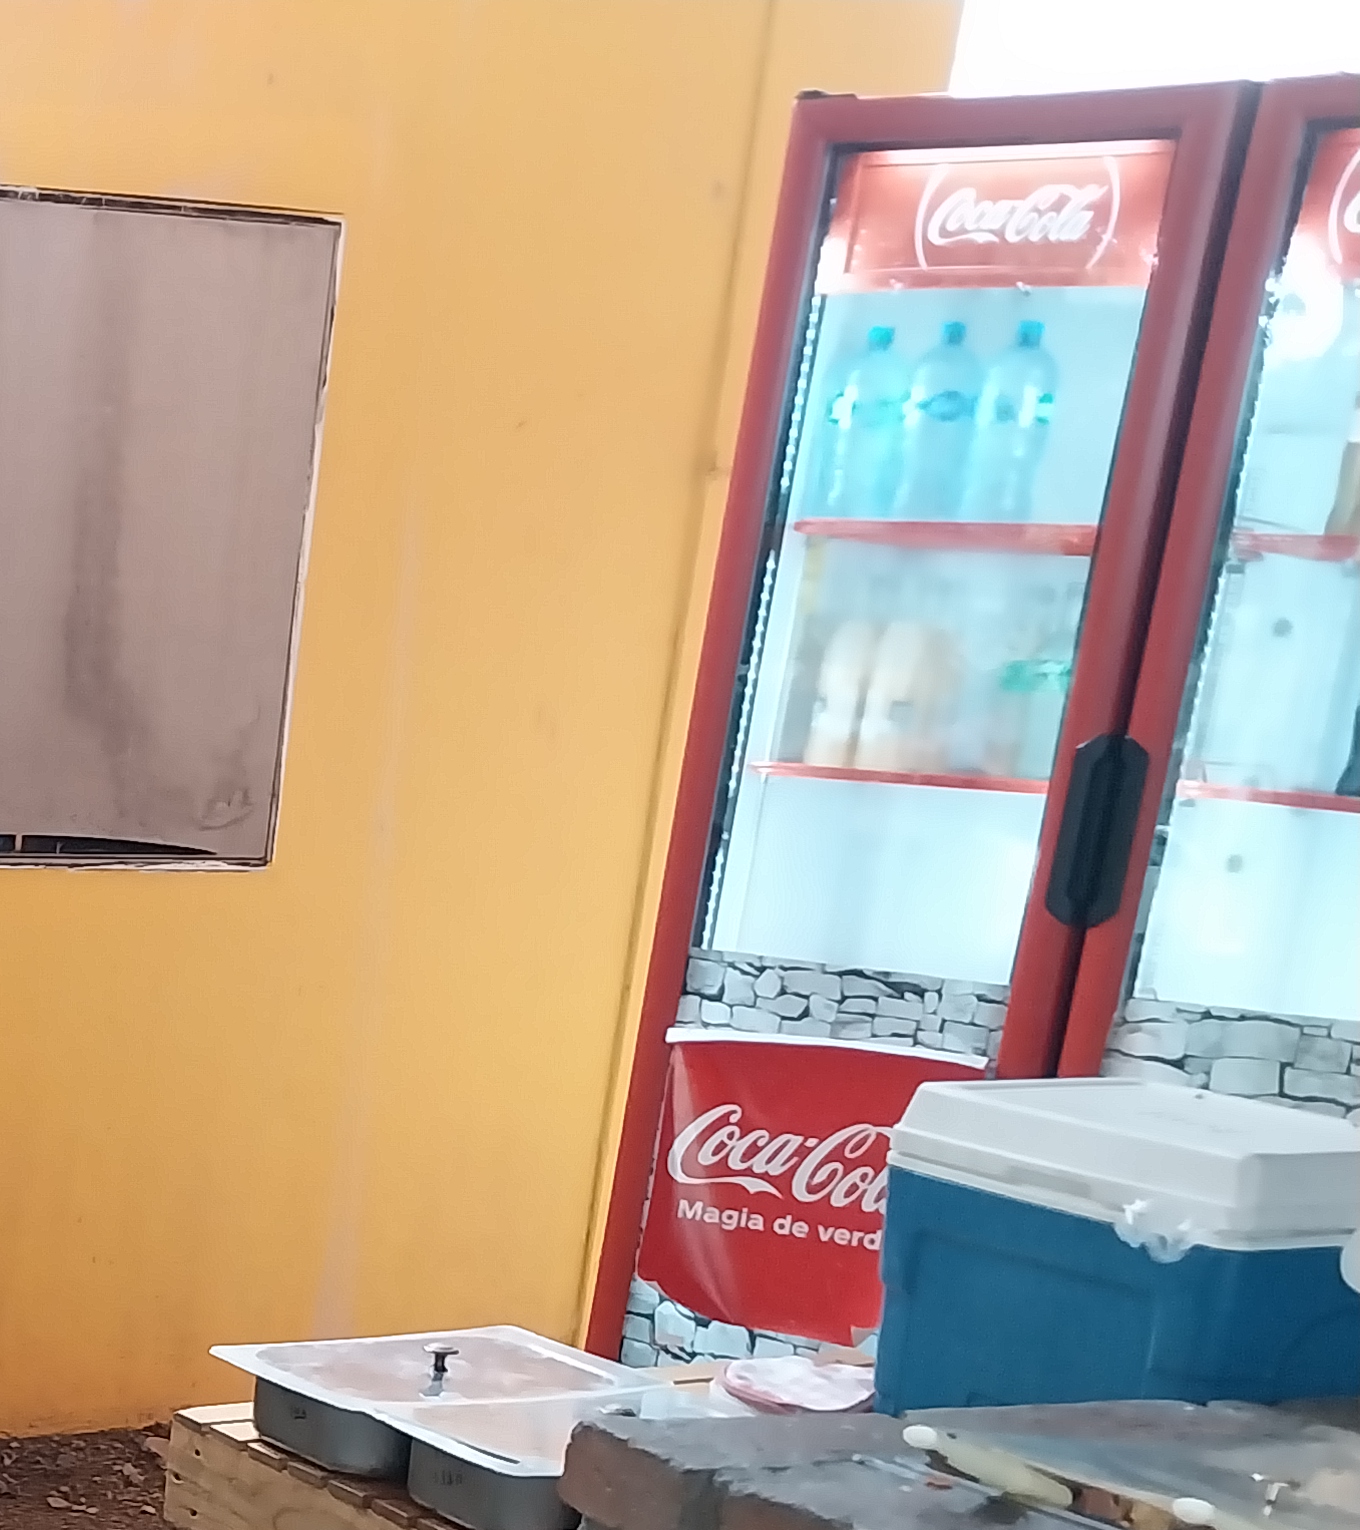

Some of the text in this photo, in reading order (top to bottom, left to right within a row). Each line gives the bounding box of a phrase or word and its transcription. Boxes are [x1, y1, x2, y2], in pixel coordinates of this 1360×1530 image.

[927, 183, 1109, 246] Coca-Cola
[667, 1104, 891, 1214] Coca-Col
[677, 1199, 883, 1251] Magia de verd
